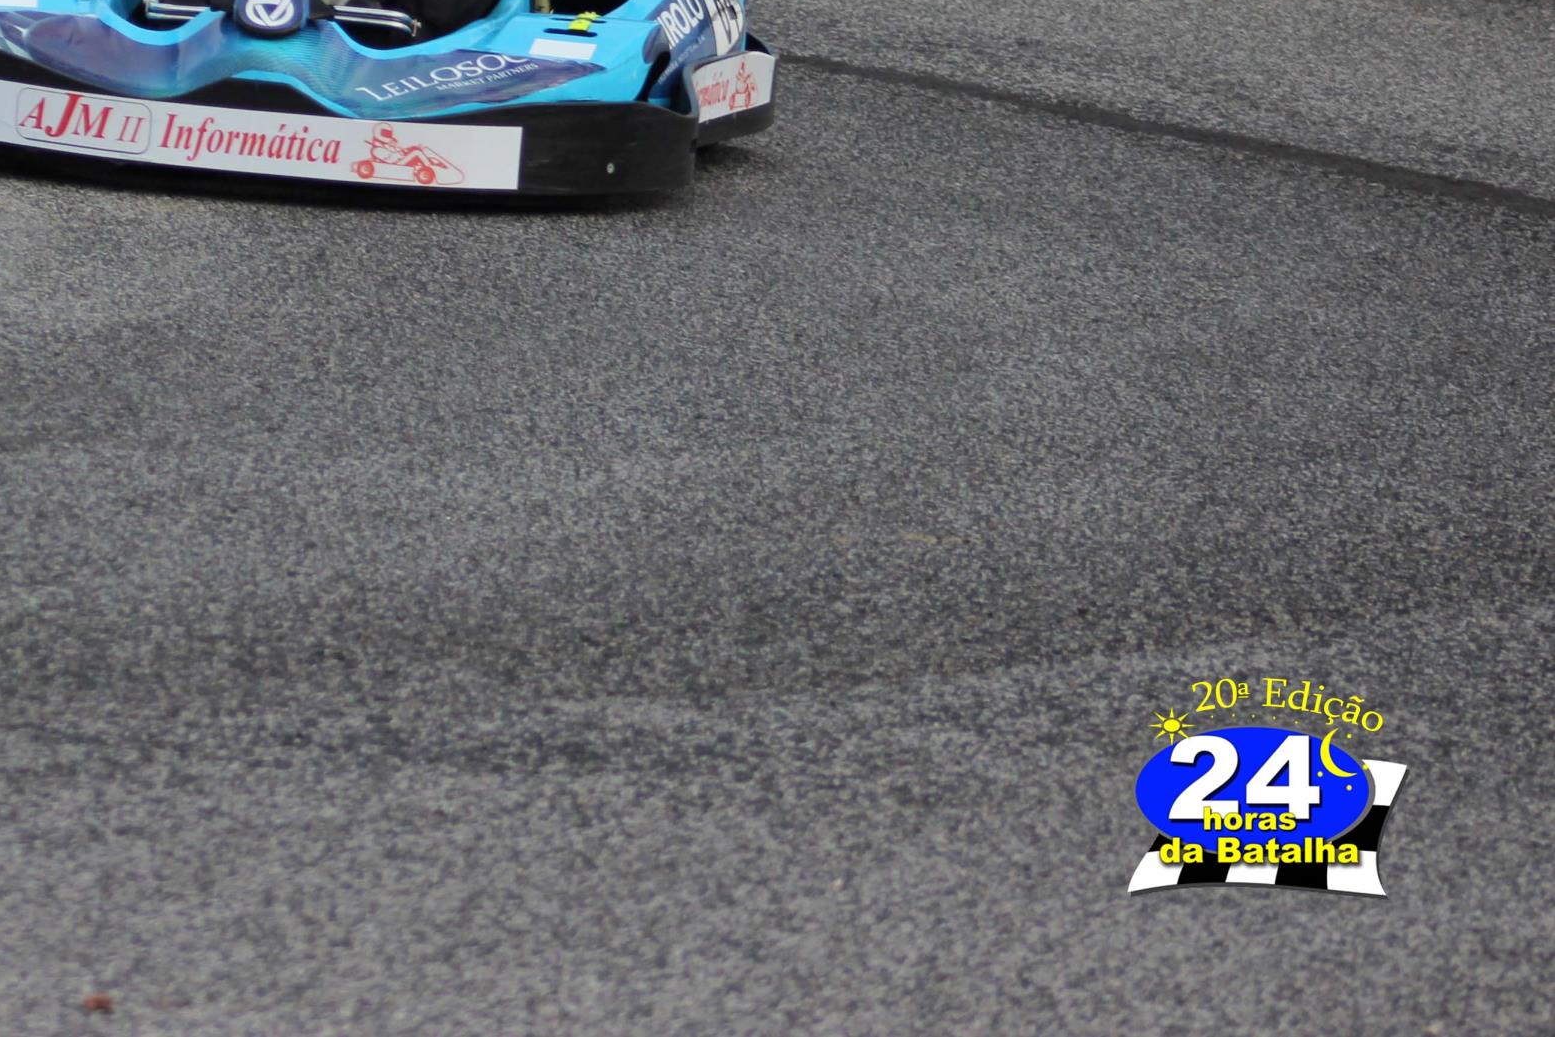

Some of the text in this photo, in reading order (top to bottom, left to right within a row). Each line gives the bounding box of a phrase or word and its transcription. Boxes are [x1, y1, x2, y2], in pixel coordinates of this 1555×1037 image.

[436, 63, 539, 91] MARKET PARTNERS
[19, 92, 342, 164] AJM II Informática
